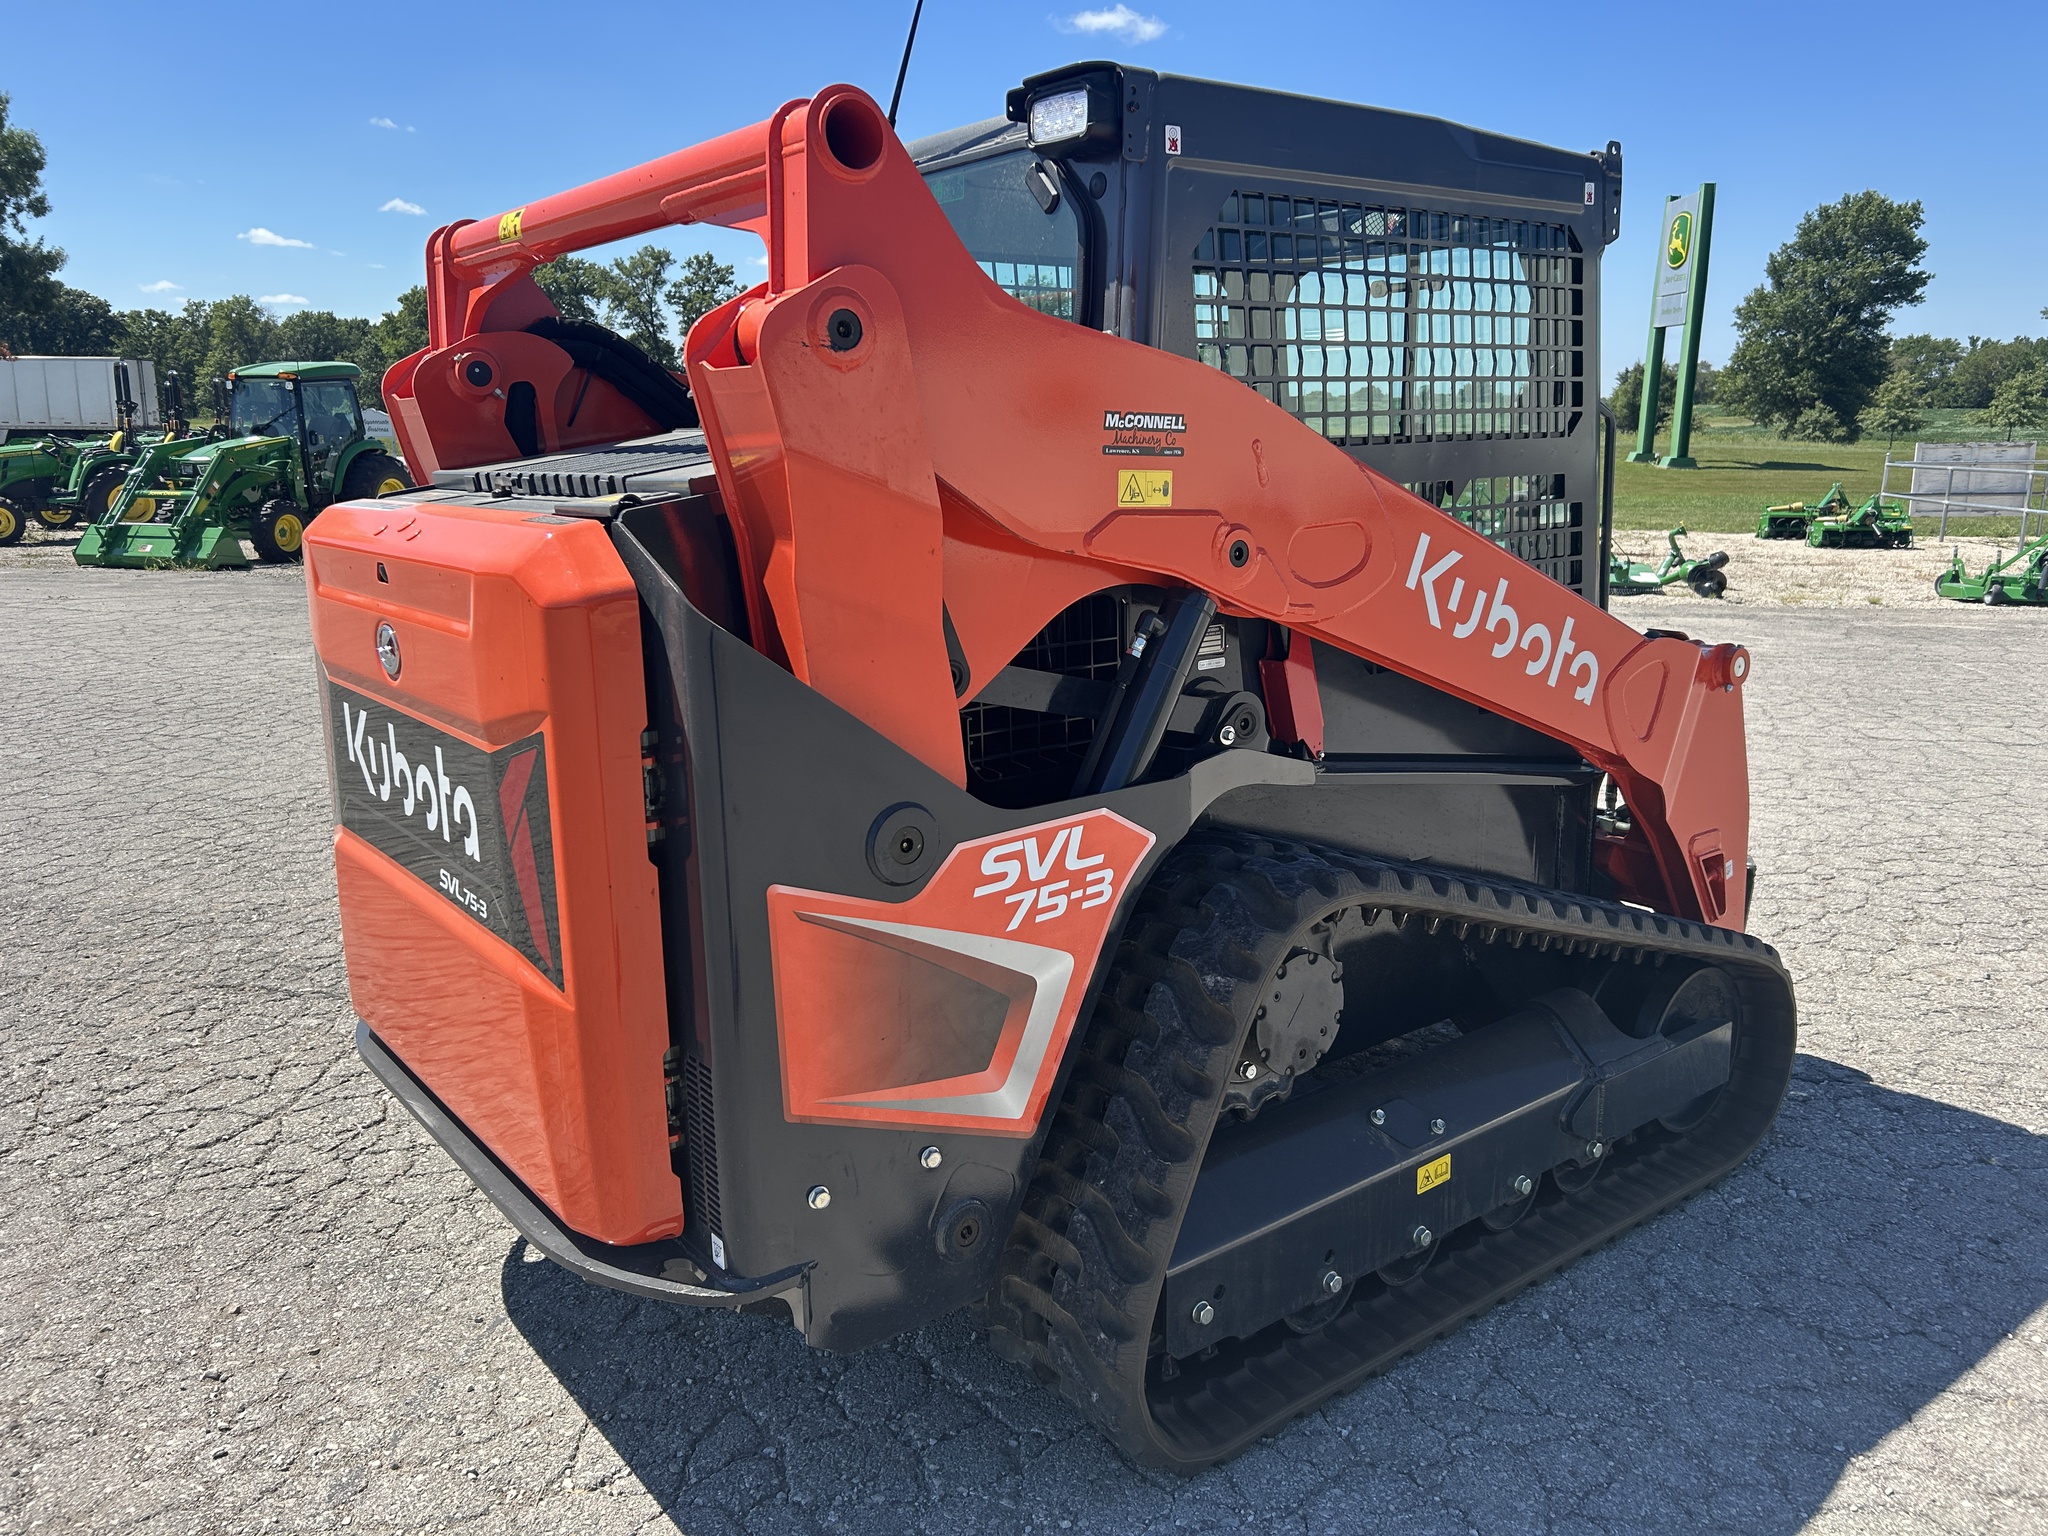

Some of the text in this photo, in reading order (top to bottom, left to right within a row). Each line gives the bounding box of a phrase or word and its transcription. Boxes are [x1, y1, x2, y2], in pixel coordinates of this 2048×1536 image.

[1105, 413, 1186, 430] McCONNELL
[1105, 447, 1131, 455] Lawrence,
[1111, 428, 1177, 452] Machinery Co
[1405, 532, 1599, 706] Kubota
[343, 701, 481, 862] Kubota
[973, 825, 1105, 898] SVL
[1004, 868, 1114, 932] 75-3
